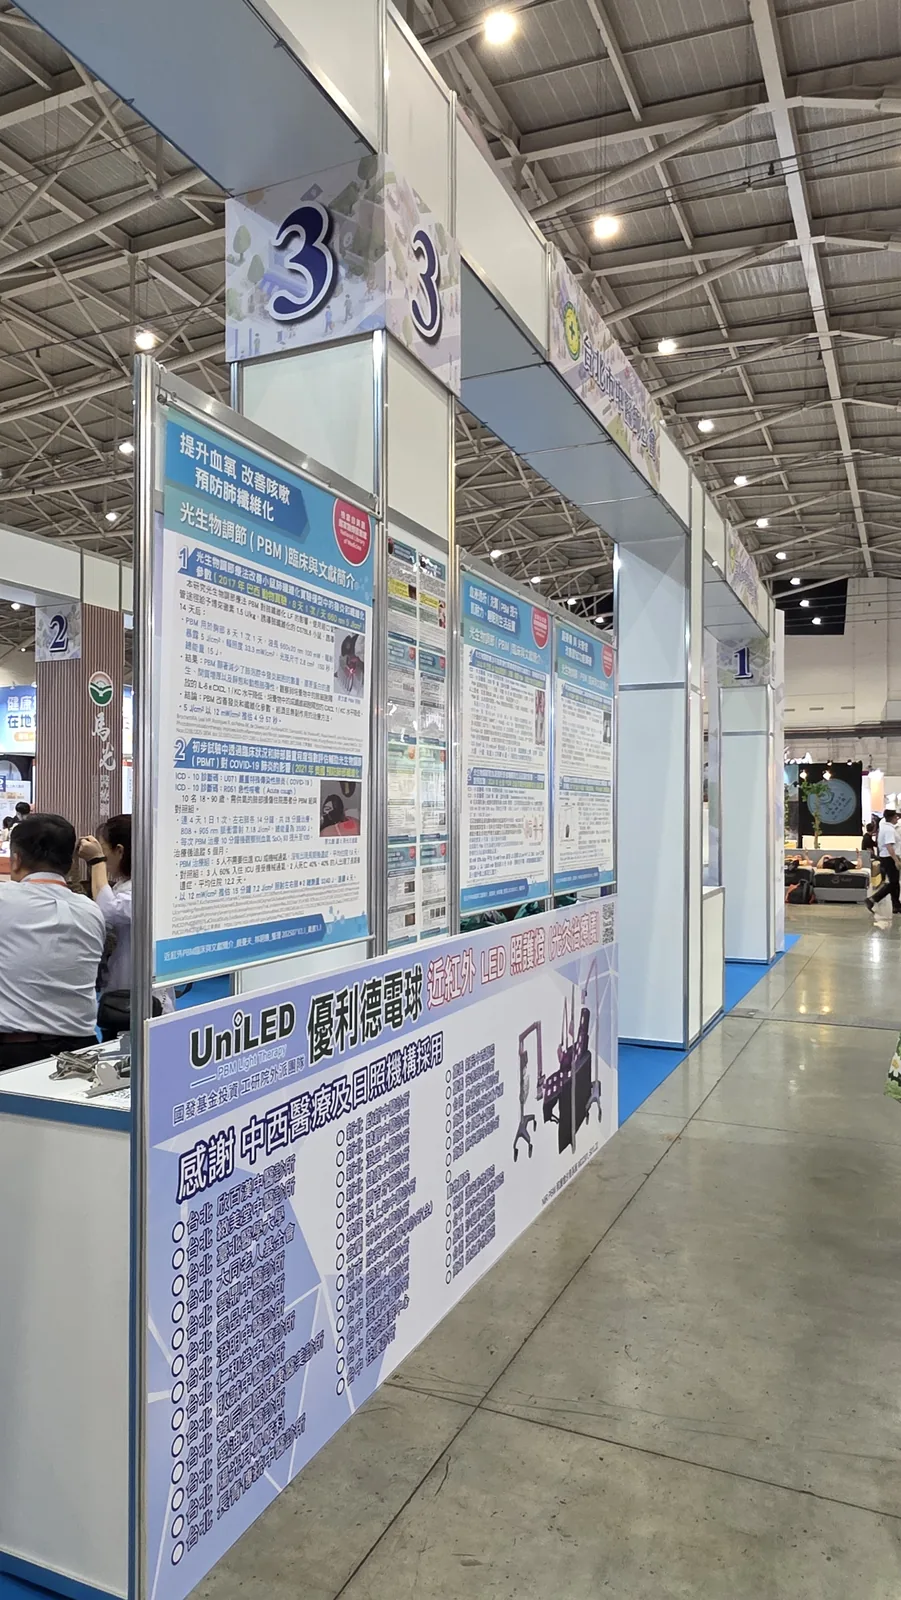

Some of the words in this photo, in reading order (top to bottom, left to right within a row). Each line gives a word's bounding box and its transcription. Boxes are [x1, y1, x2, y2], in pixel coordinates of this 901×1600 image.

[270, 201, 334, 321] 3
[410, 229, 440, 339] 3
[180, 432, 236, 480] 提升血氧
[241, 463, 290, 506] 改善咳嗽
[195, 467, 273, 522] 預防肺纖維化
[180, 501, 246, 547] 光生物調節
[178, 543, 188, 570] 1
[50, 614, 67, 651] 2
[734, 647, 752, 679] 1
[8, 714, 36, 728] 在地
[173, 737, 185, 760] 2
[190, 1000, 295, 1068] UniLED
[307, 962, 422, 1065] 優利德電球
[427, 946, 475, 1010] 近紅外
[480, 943, 505, 986] LED
[172, 1081, 237, 1126] 國發基金投資
[177, 1126, 233, 1204] 感謝
[239, 1028, 443, 1170] 中西醫療及日照機構採用
[186, 1199, 212, 1236] 台北
[186, 1224, 212, 1262] 台北
[186, 1275, 212, 1315] 台北
[216, 1219, 295, 1294] 大同老人基金會
[186, 1250, 212, 1289] 台北
[186, 1301, 212, 1341] 台北
[186, 1326, 212, 1368] 台北
[186, 1351, 212, 1394] 台北
[186, 1377, 212, 1420] 台北
[186, 1402, 212, 1447] 台北
[186, 1428, 212, 1473] 台北
[186, 1453, 212, 1499] 台北
[186, 1478, 212, 1526] 台北
[186, 1504, 212, 1552] 台北
